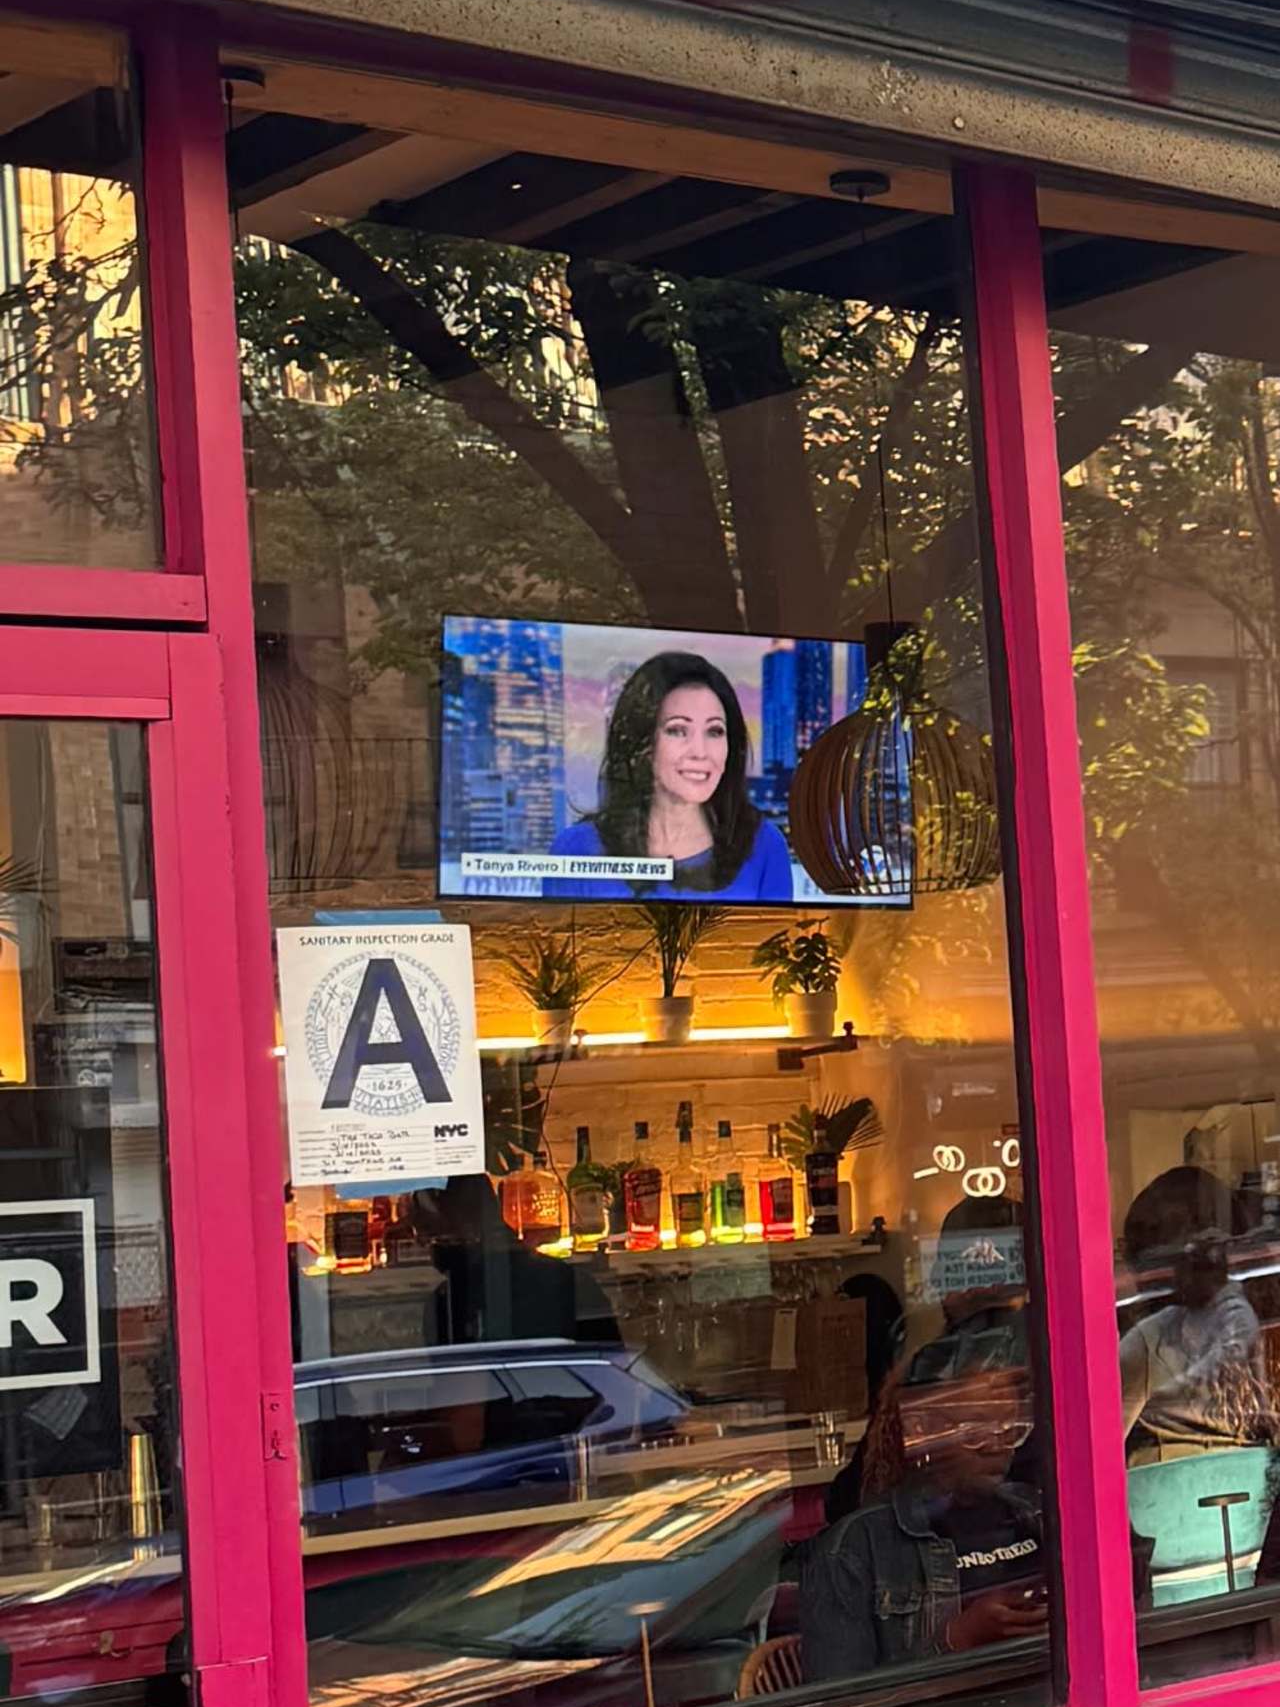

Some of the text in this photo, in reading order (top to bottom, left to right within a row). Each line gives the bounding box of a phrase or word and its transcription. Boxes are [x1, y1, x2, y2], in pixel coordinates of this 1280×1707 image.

[474, 857, 668, 877] Tanya Rivero EYEWITNESS NEWS
[299, 933, 455, 947] SANITARY INSPECTION GRADE
[320, 957, 453, 1110] A
[433, 1123, 469, 1138] NYC
